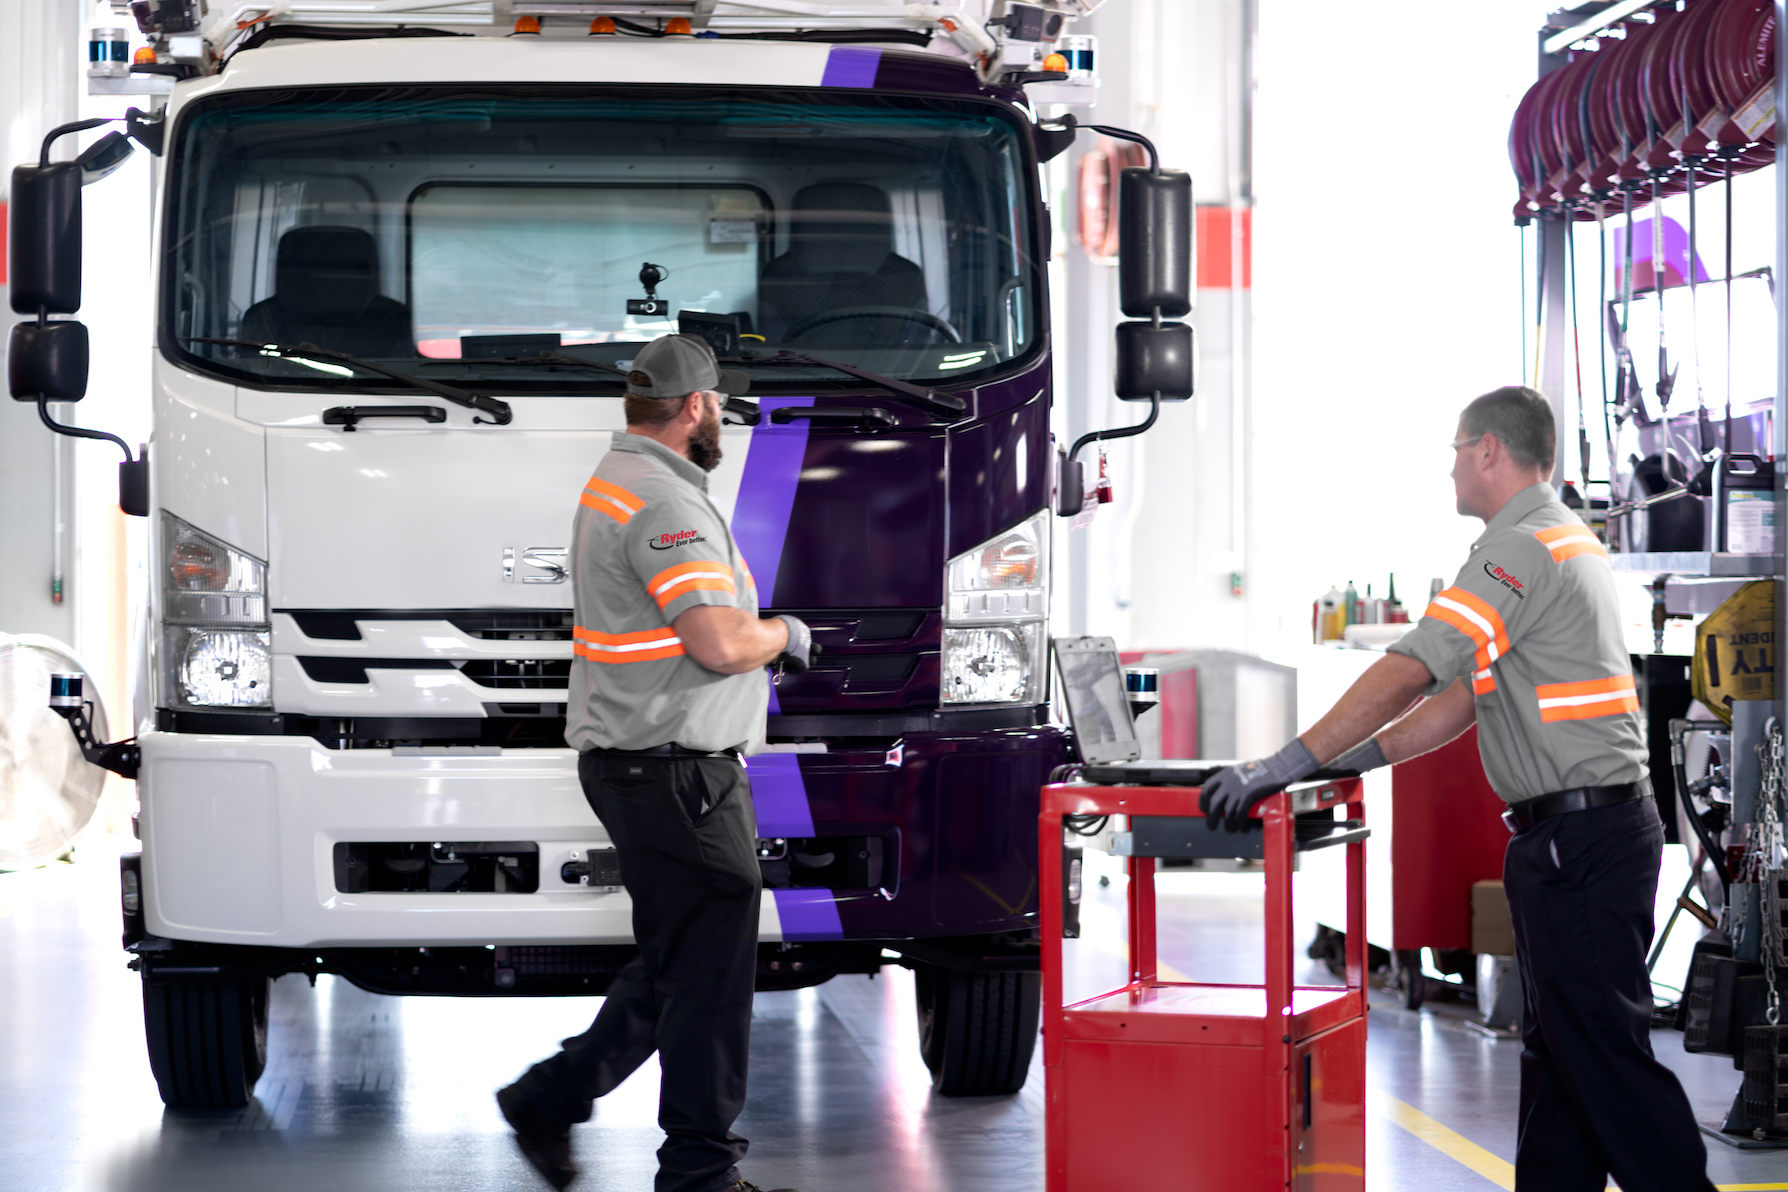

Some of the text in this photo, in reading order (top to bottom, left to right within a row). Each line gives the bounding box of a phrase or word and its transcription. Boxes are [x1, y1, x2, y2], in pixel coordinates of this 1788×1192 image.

[660, 530, 698, 545] Ryder
[676, 539, 689, 547] Ever
[1492, 566, 1525, 589] Ryder
